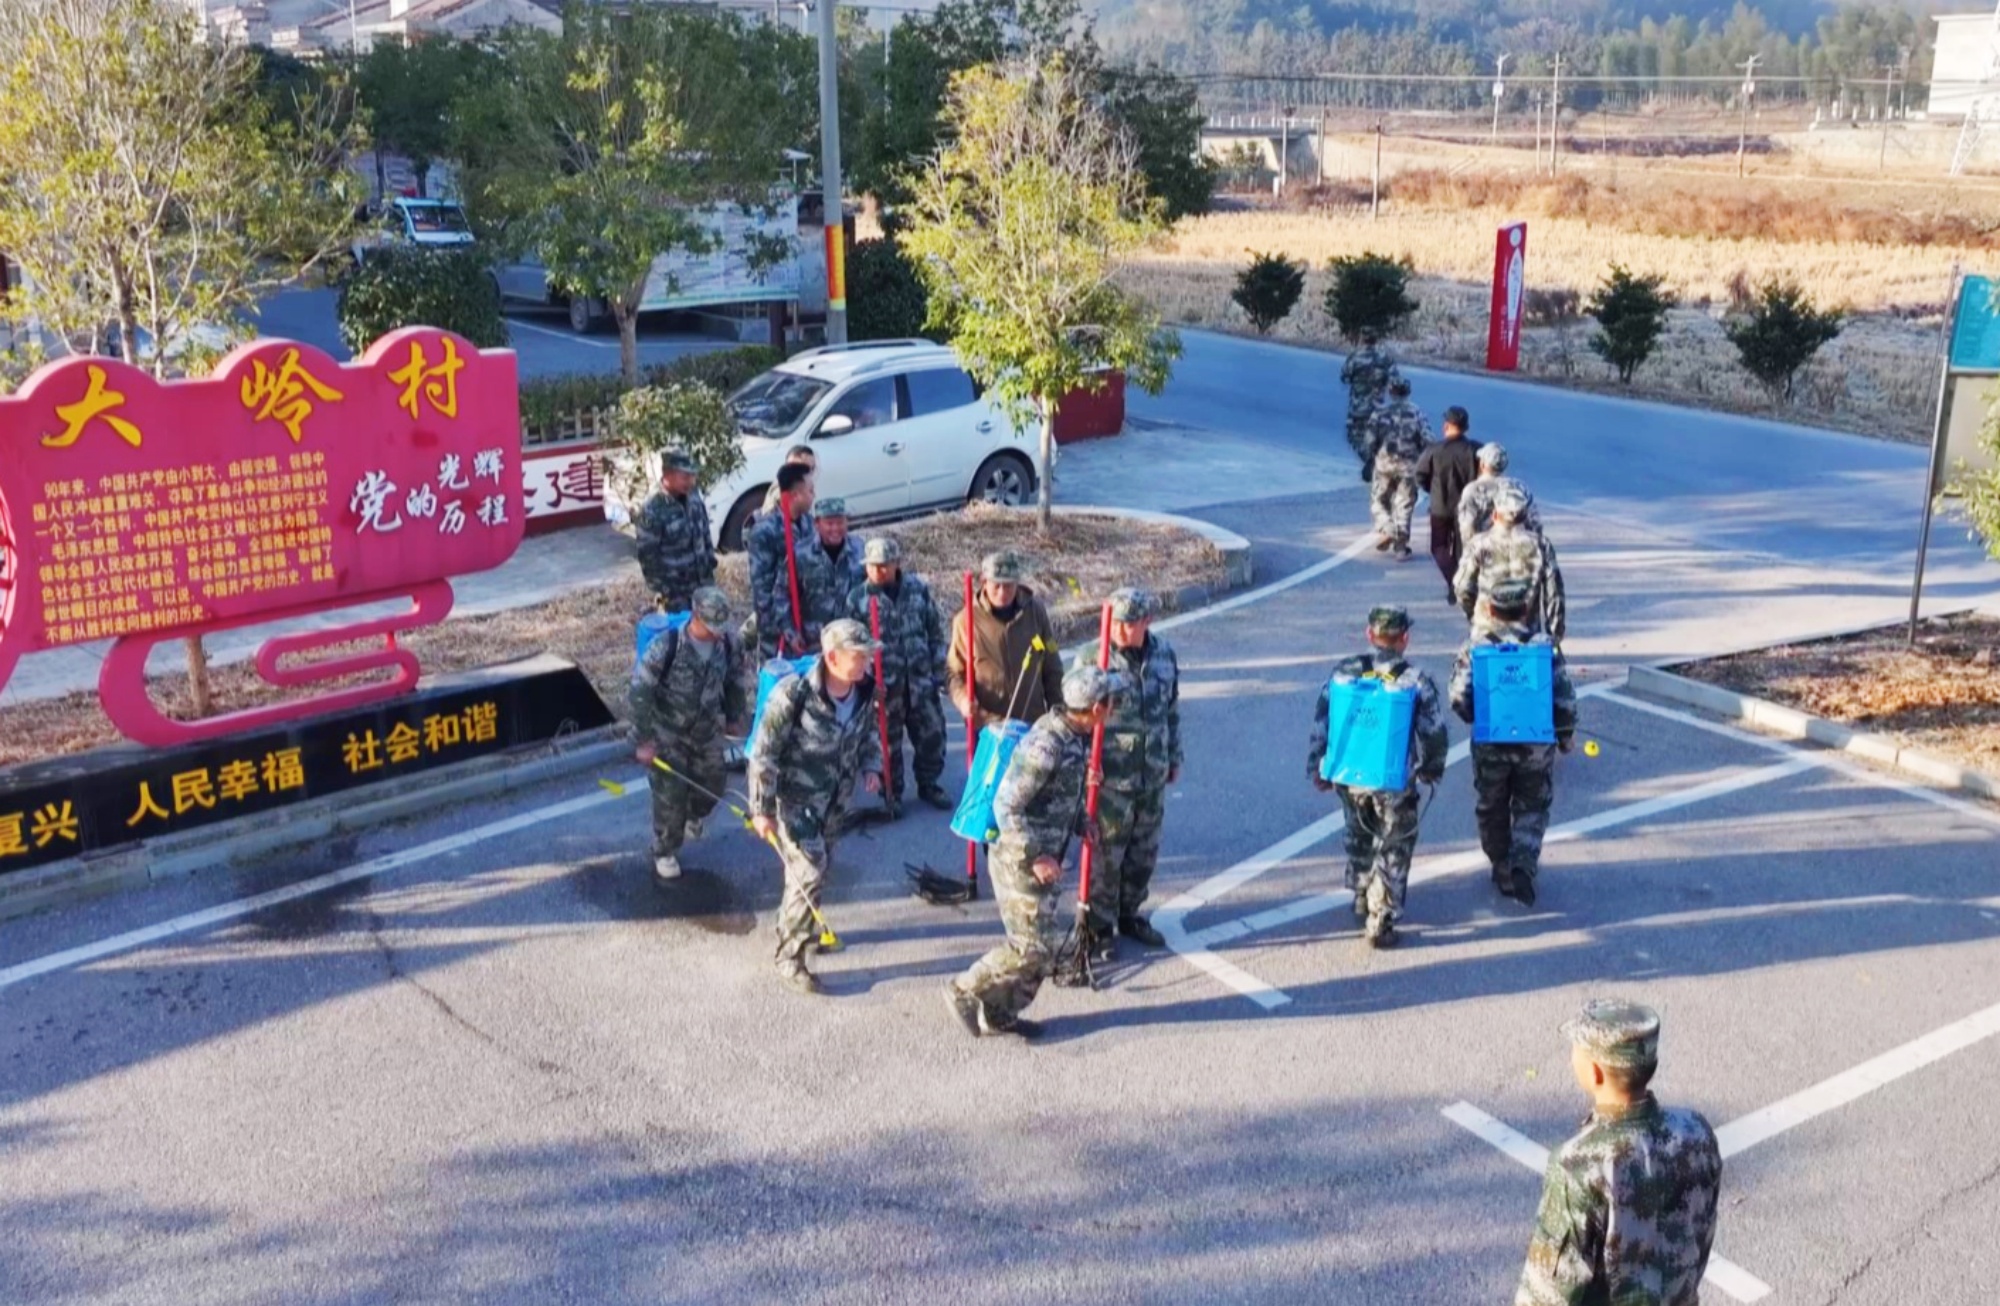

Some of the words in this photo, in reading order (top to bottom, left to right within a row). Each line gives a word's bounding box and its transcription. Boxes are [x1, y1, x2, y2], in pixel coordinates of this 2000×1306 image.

[41, 337, 464, 447] 大岭村
[437, 447, 504, 489] 光辉
[522, 453, 607, 516] 建
[350, 469, 437, 534] 党的
[439, 494, 509, 535] 历程
[126, 746, 304, 826] 人民幸福
[342, 701, 498, 773] 社会和谐
